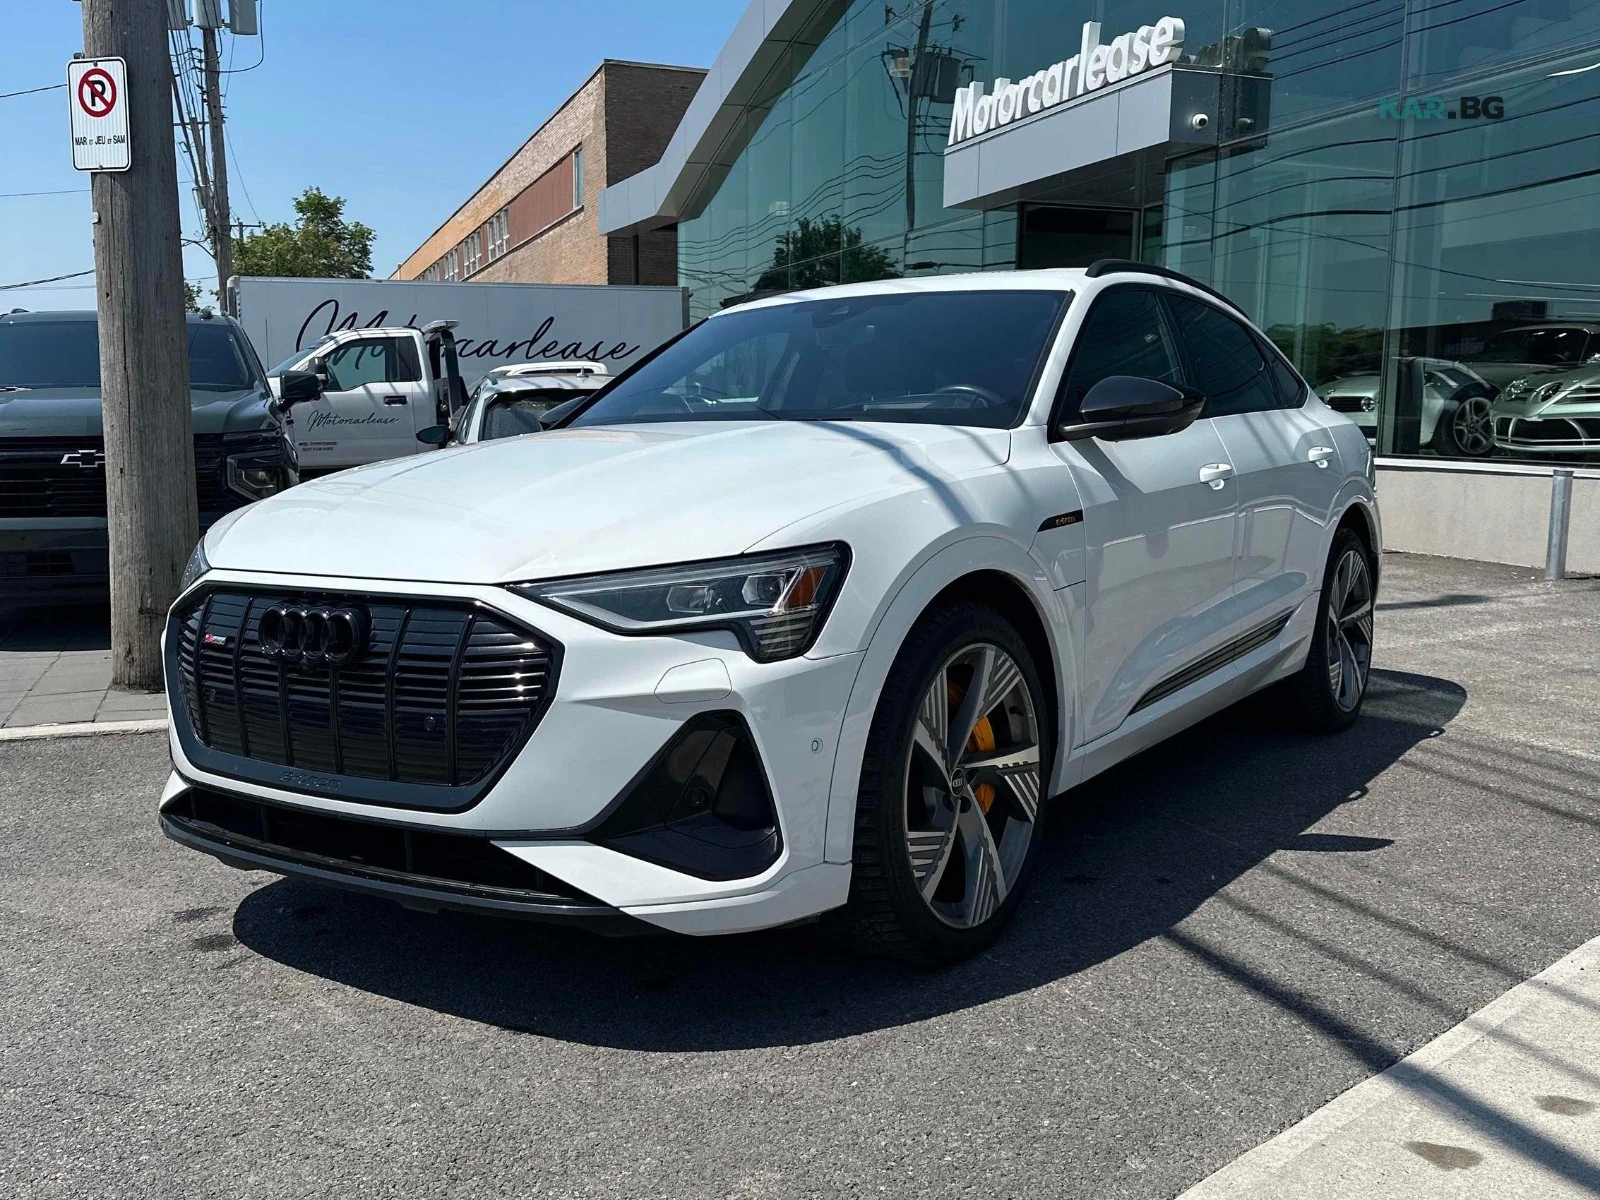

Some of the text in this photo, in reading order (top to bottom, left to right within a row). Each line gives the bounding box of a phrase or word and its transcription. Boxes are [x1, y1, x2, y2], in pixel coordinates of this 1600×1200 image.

[947, 15, 1186, 146] Motorcarlease
[75, 136, 88, 146] MAR
[95, 135, 106, 145] JEU
[113, 135, 126, 144] SAM
[307, 409, 400, 432] Motorcarlease
